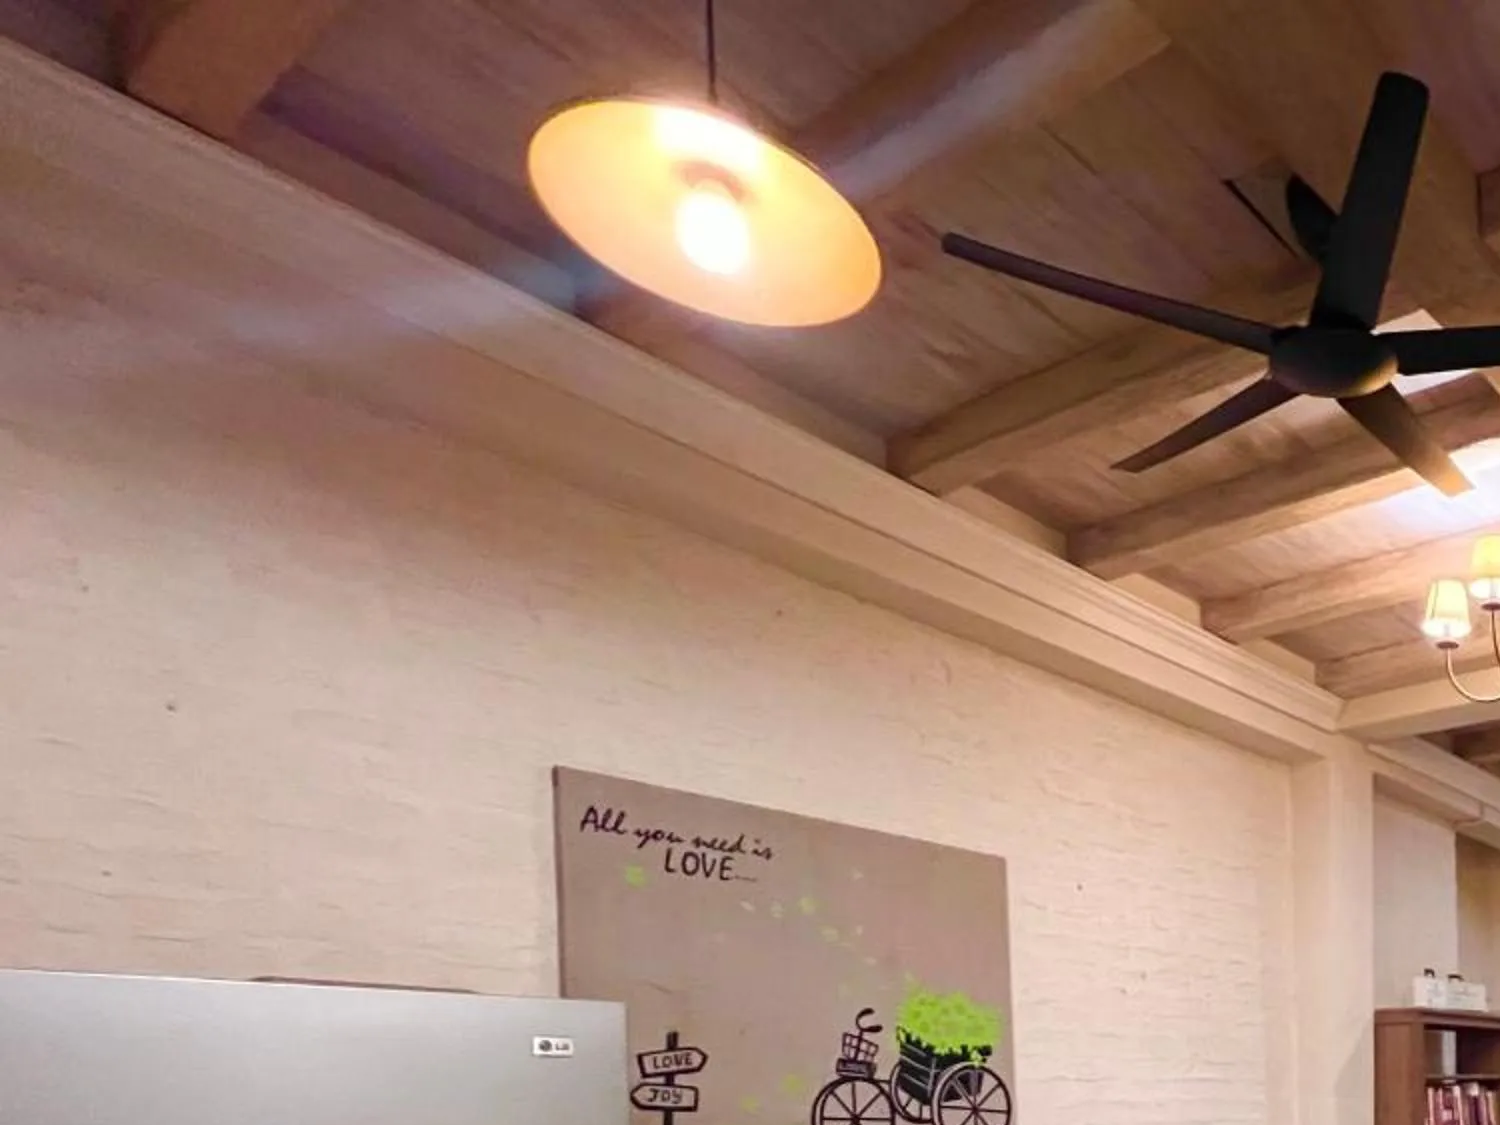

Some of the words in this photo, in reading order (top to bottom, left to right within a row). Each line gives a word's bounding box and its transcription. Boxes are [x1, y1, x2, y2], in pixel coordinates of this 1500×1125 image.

[580, 805, 627, 835] All
[633, 828, 685, 849] you
[692, 833, 746, 854] need
[752, 838, 773, 861] is
[653, 1052, 693, 1069] LOVE
[648, 1087, 682, 1105] JOY
